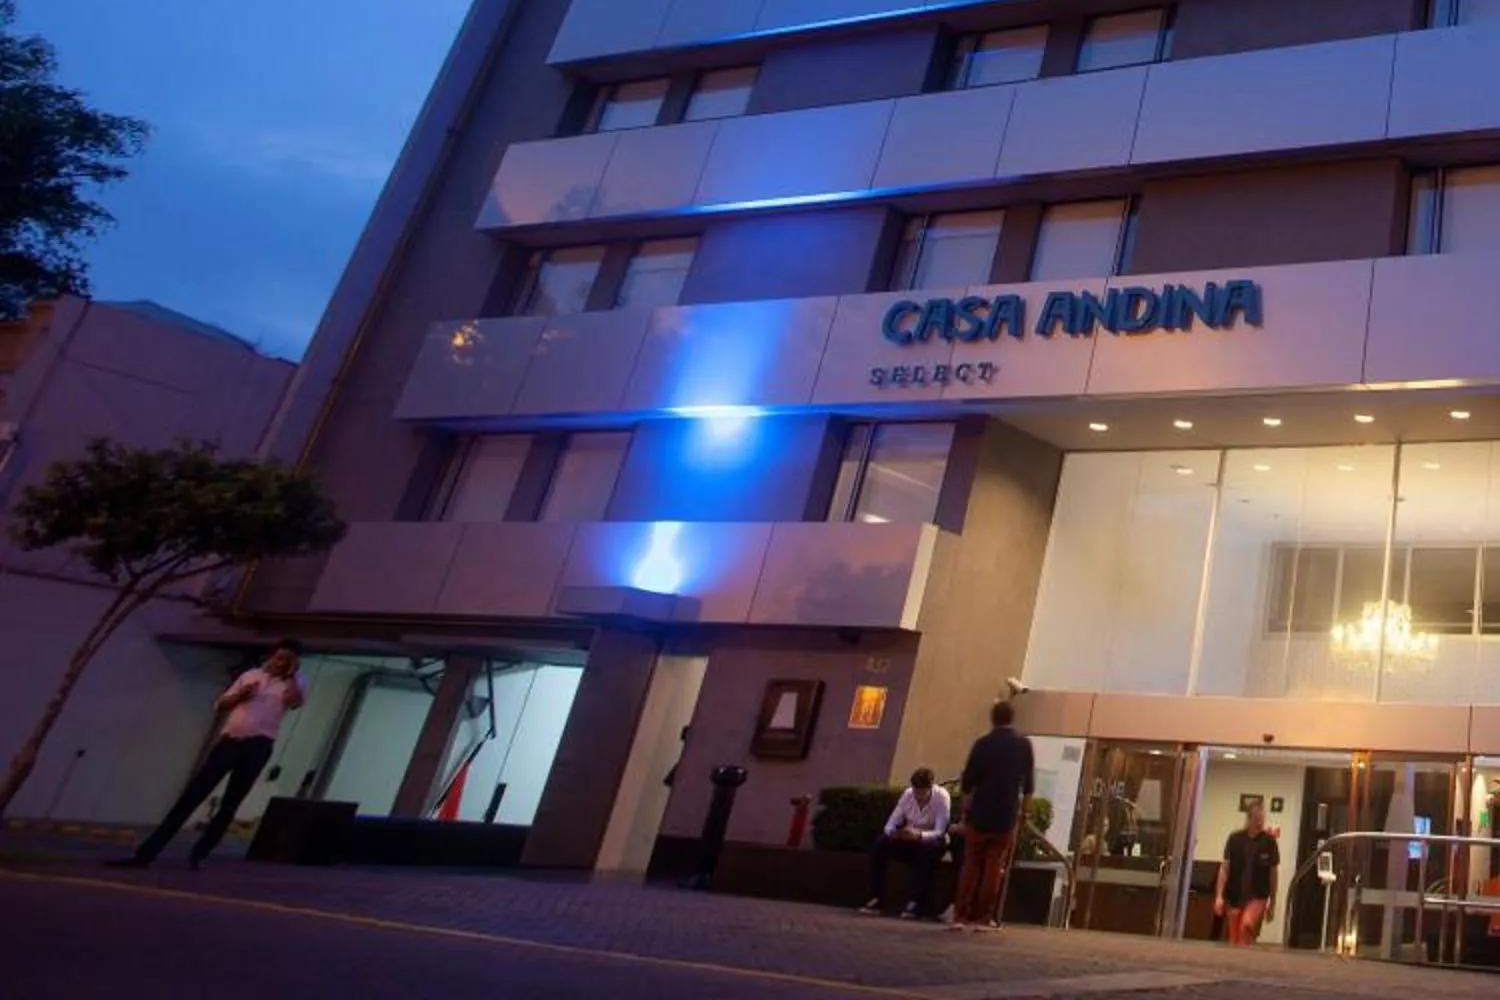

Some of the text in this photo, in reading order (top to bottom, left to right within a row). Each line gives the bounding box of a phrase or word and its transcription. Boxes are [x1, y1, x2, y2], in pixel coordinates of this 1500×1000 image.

[881, 278, 1263, 347] CASA ANDINA
[869, 361, 997, 387] SELECT
